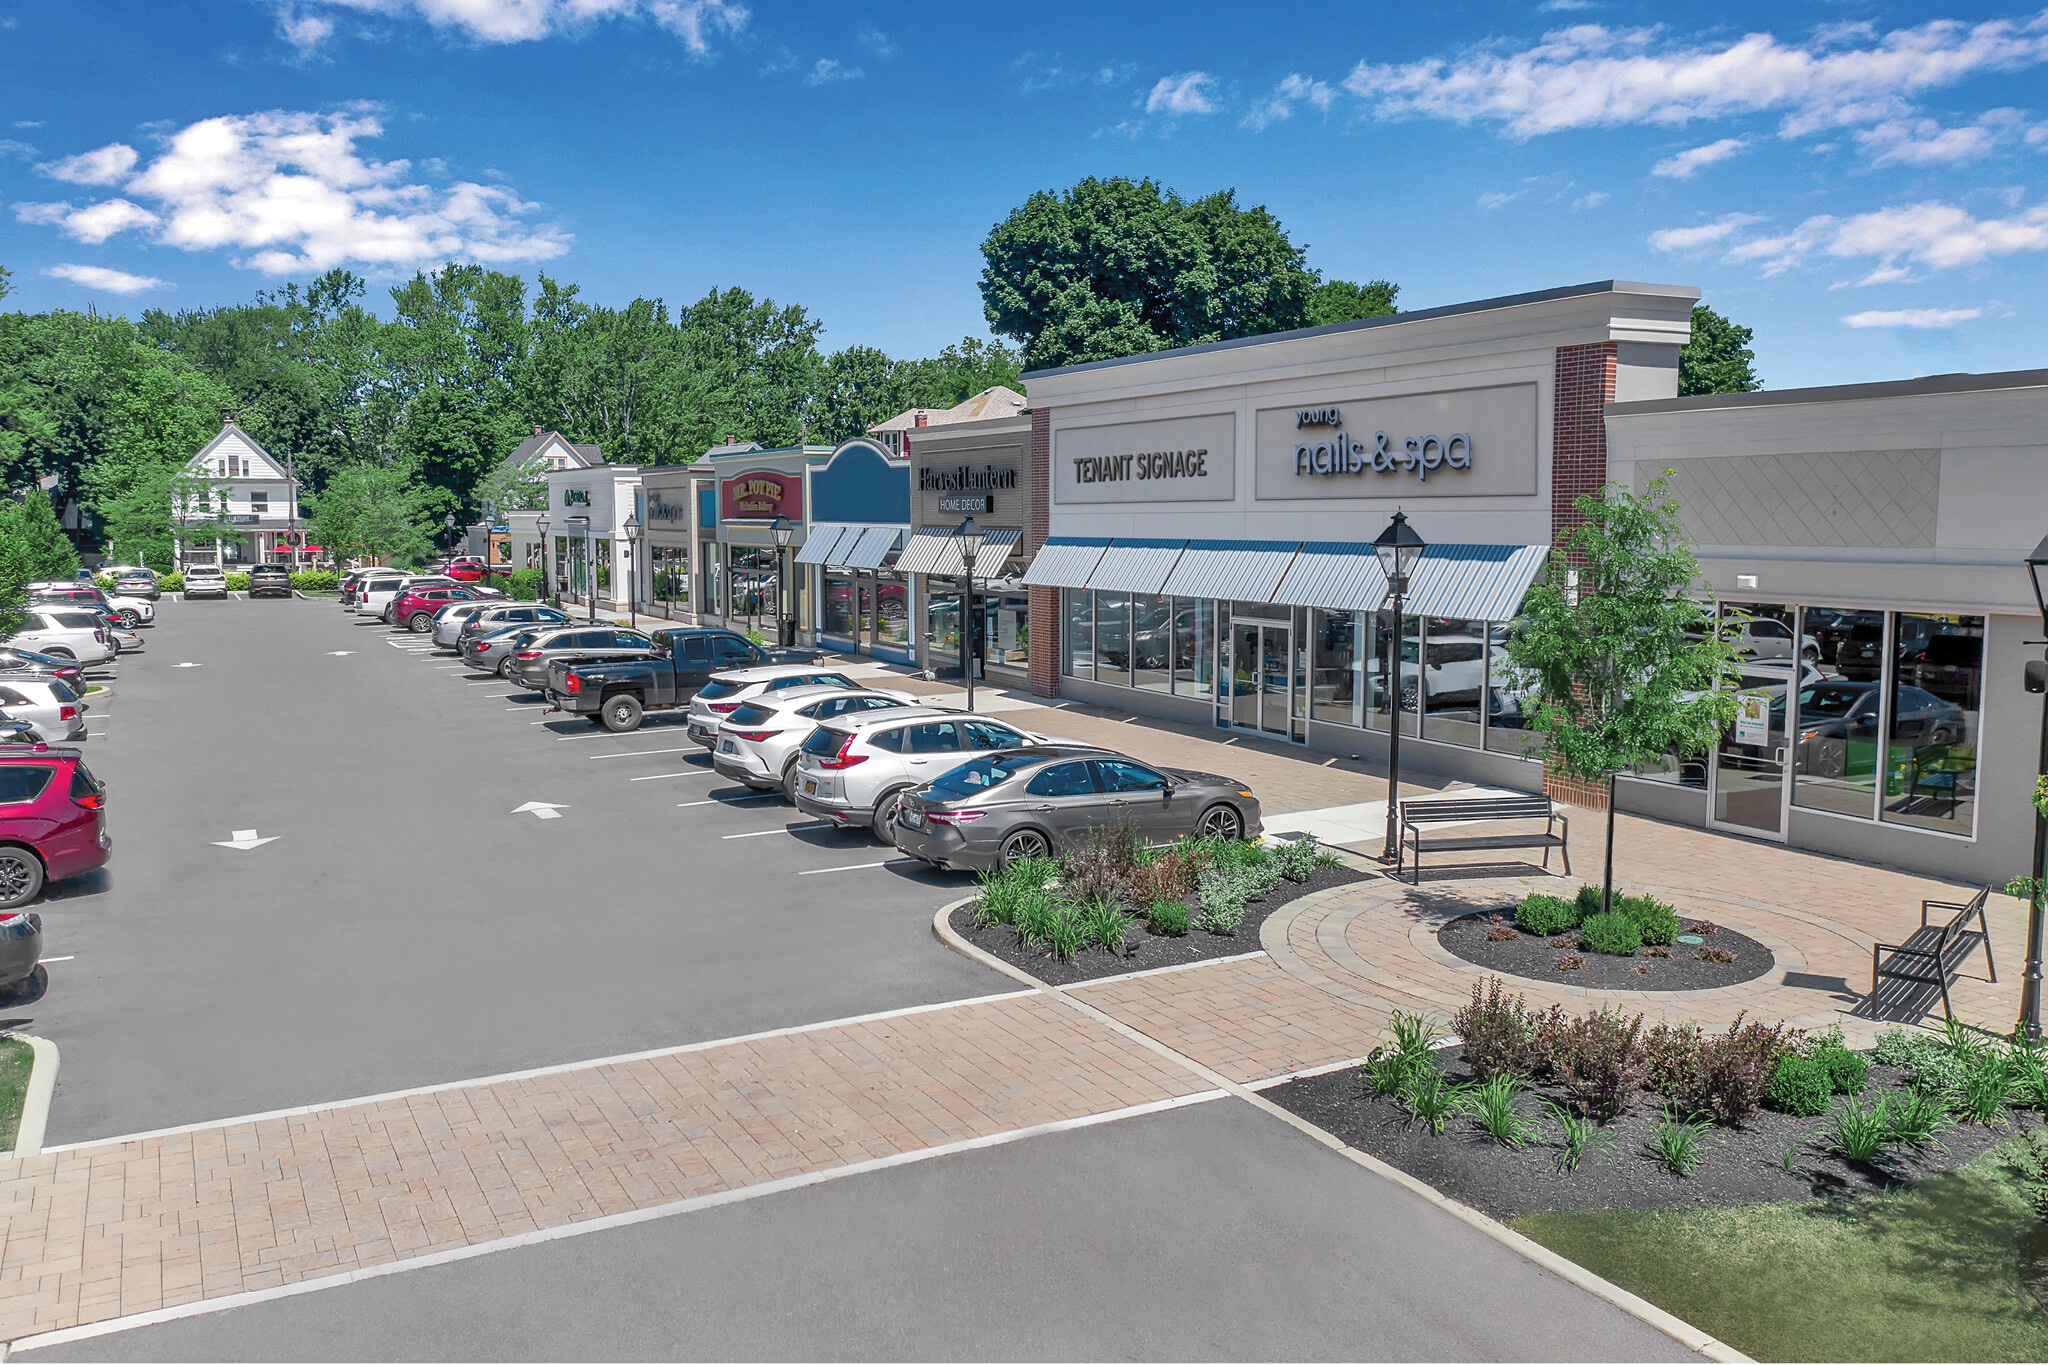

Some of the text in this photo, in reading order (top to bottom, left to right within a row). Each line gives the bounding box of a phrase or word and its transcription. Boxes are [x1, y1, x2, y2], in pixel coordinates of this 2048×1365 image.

[1295, 406, 1342, 430] young
[1073, 449, 1208, 484] TENANT SIGNAGE
[1293, 430, 1472, 482] nails & spa
[733, 480, 782, 501] MR. POT PIE
[917, 465, 1016, 491] Harvest Lantern
[940, 498, 985, 511] HOME DECOR
